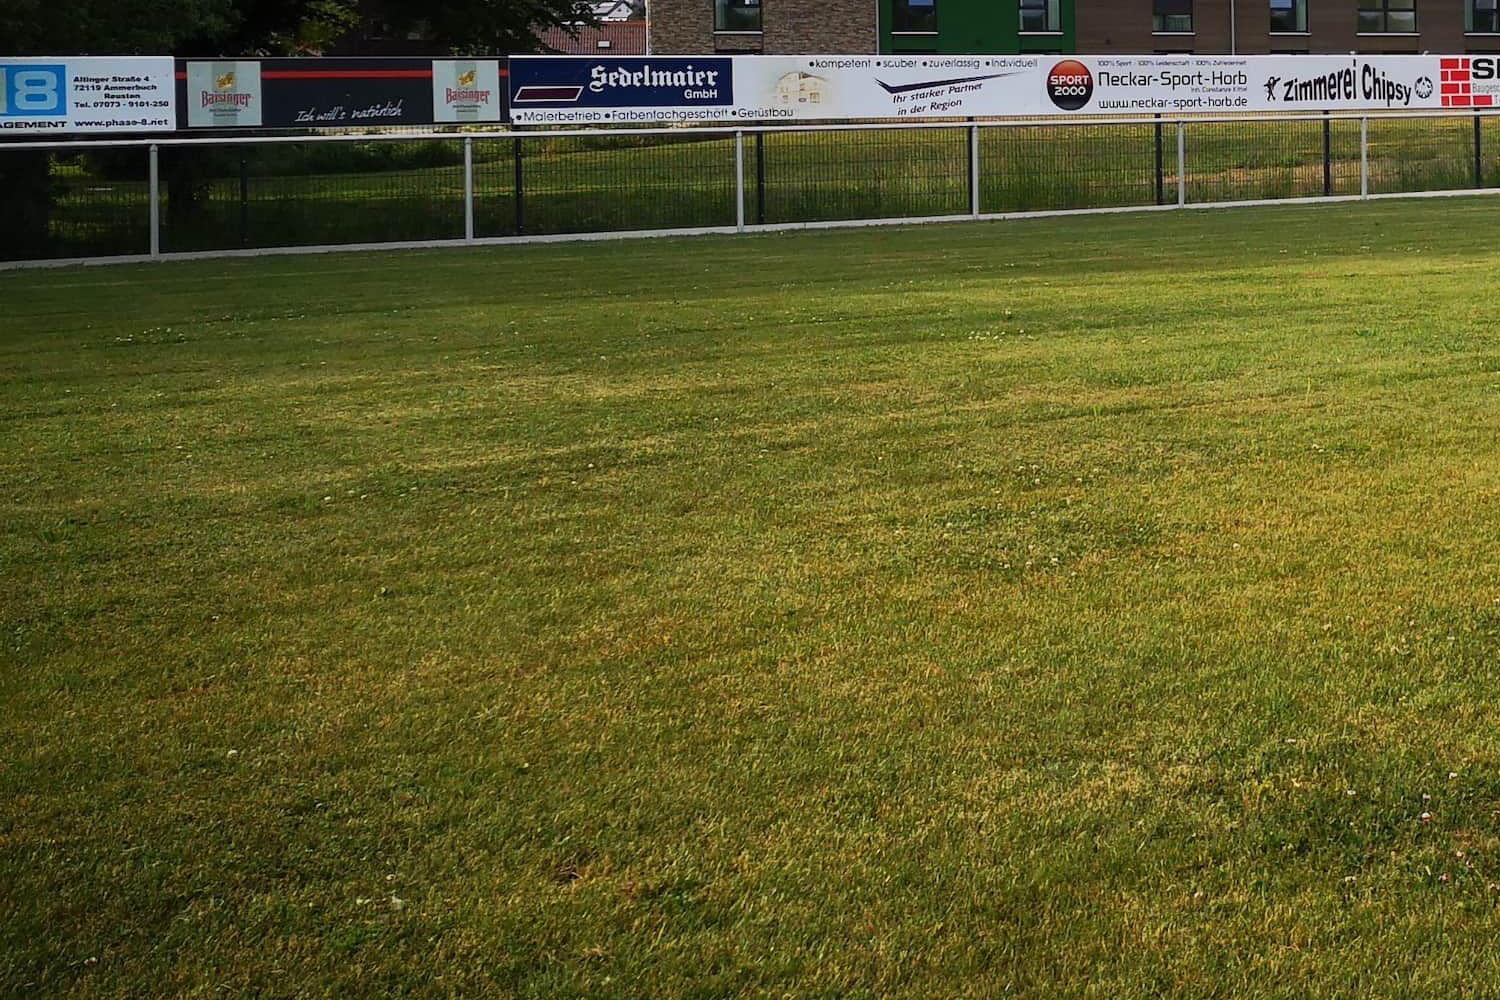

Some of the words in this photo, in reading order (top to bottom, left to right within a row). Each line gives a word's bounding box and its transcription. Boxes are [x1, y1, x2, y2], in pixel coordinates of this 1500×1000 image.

[815, 59, 871, 70] kompetent
[882, 58, 917, 68] sauber
[589, 65, 719, 92] Sedelmaier
[1050, 75, 1089, 85] SPORT
[1283, 59, 1357, 101] Zimmerei
[1361, 63, 1411, 107] Chipsy
[14, 70, 58, 110] 8
[445, 87, 490, 105] Baisinger
[684, 89, 718, 100] GmbH
[892, 94, 908, 104] Ihr
[910, 88, 945, 101] starker
[948, 83, 983, 95] Partner
[1054, 87, 1087, 96] 2000
[201, 90, 251, 108] Baisinger
[1098, 97, 1247, 110] www.neckar-sport-horb.de
[897, 107, 907, 116] in
[910, 104, 926, 115] der
[930, 99, 962, 111] Region
[74, 119, 169, 128] www.phase-8.net
[523, 110, 602, 122] Malerbetrieb
